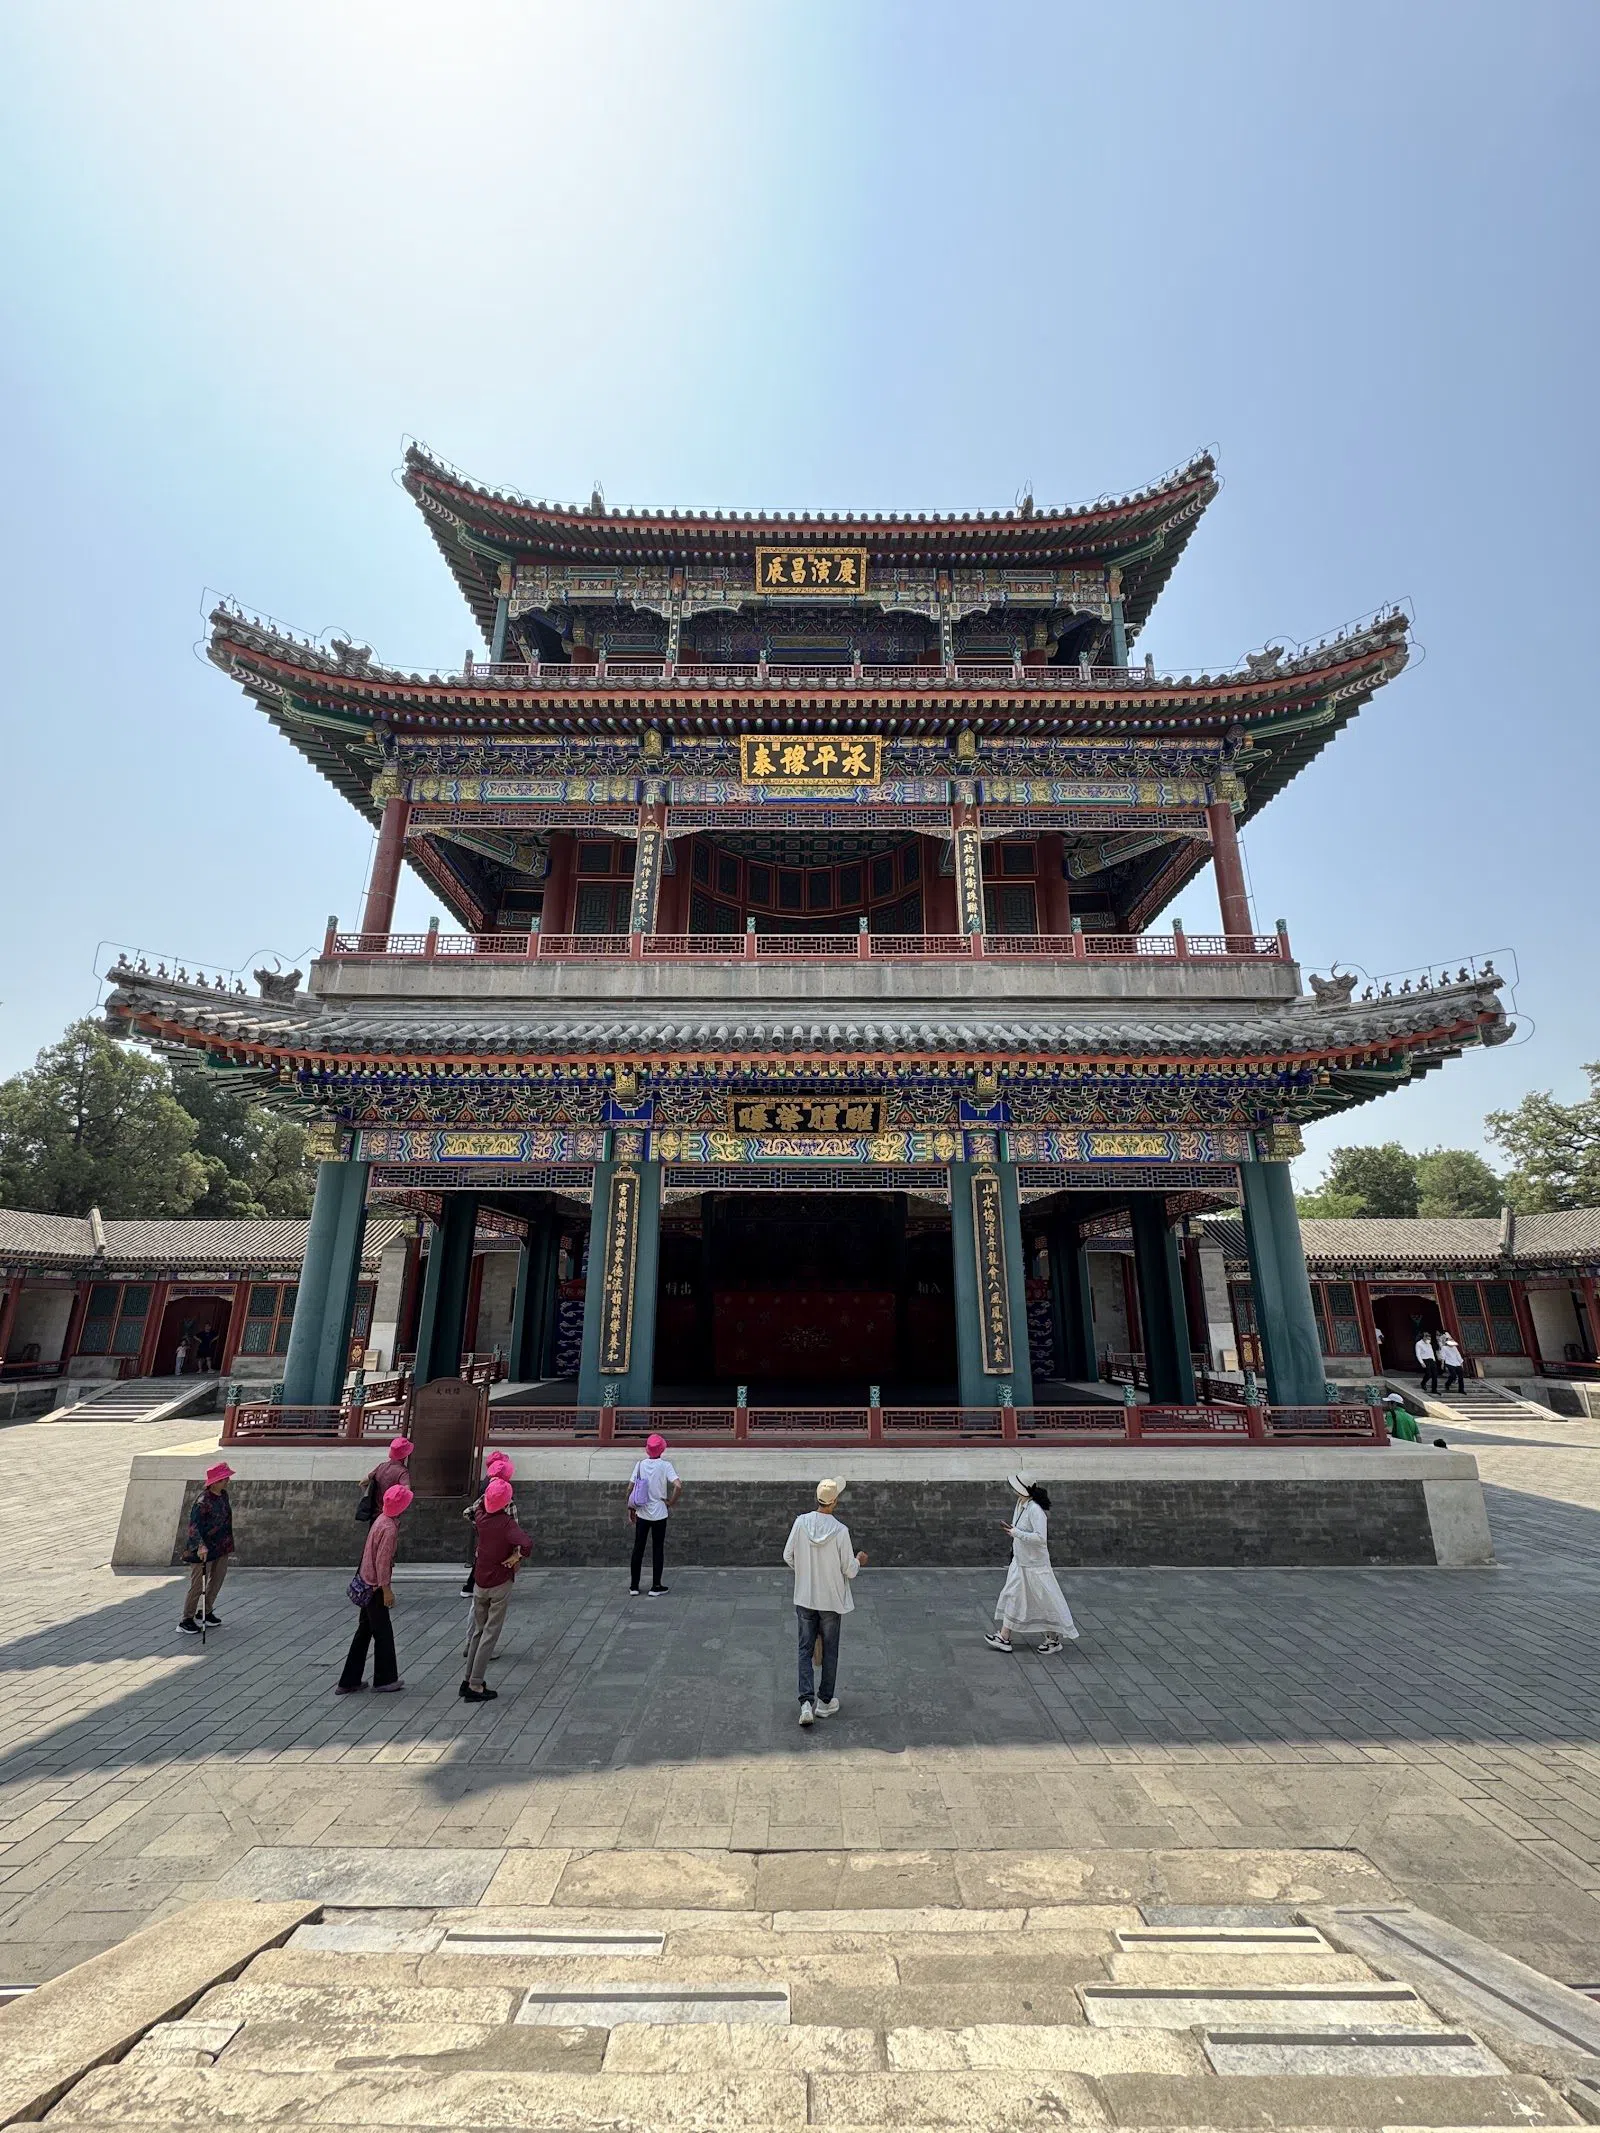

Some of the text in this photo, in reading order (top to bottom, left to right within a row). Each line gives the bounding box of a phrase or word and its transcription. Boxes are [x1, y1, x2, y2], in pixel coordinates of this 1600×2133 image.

[765, 556, 857, 585] 慶演昌辰
[751, 743, 871, 777] 承平豫泰
[638, 833, 655, 935] 四時調律呂玉節
